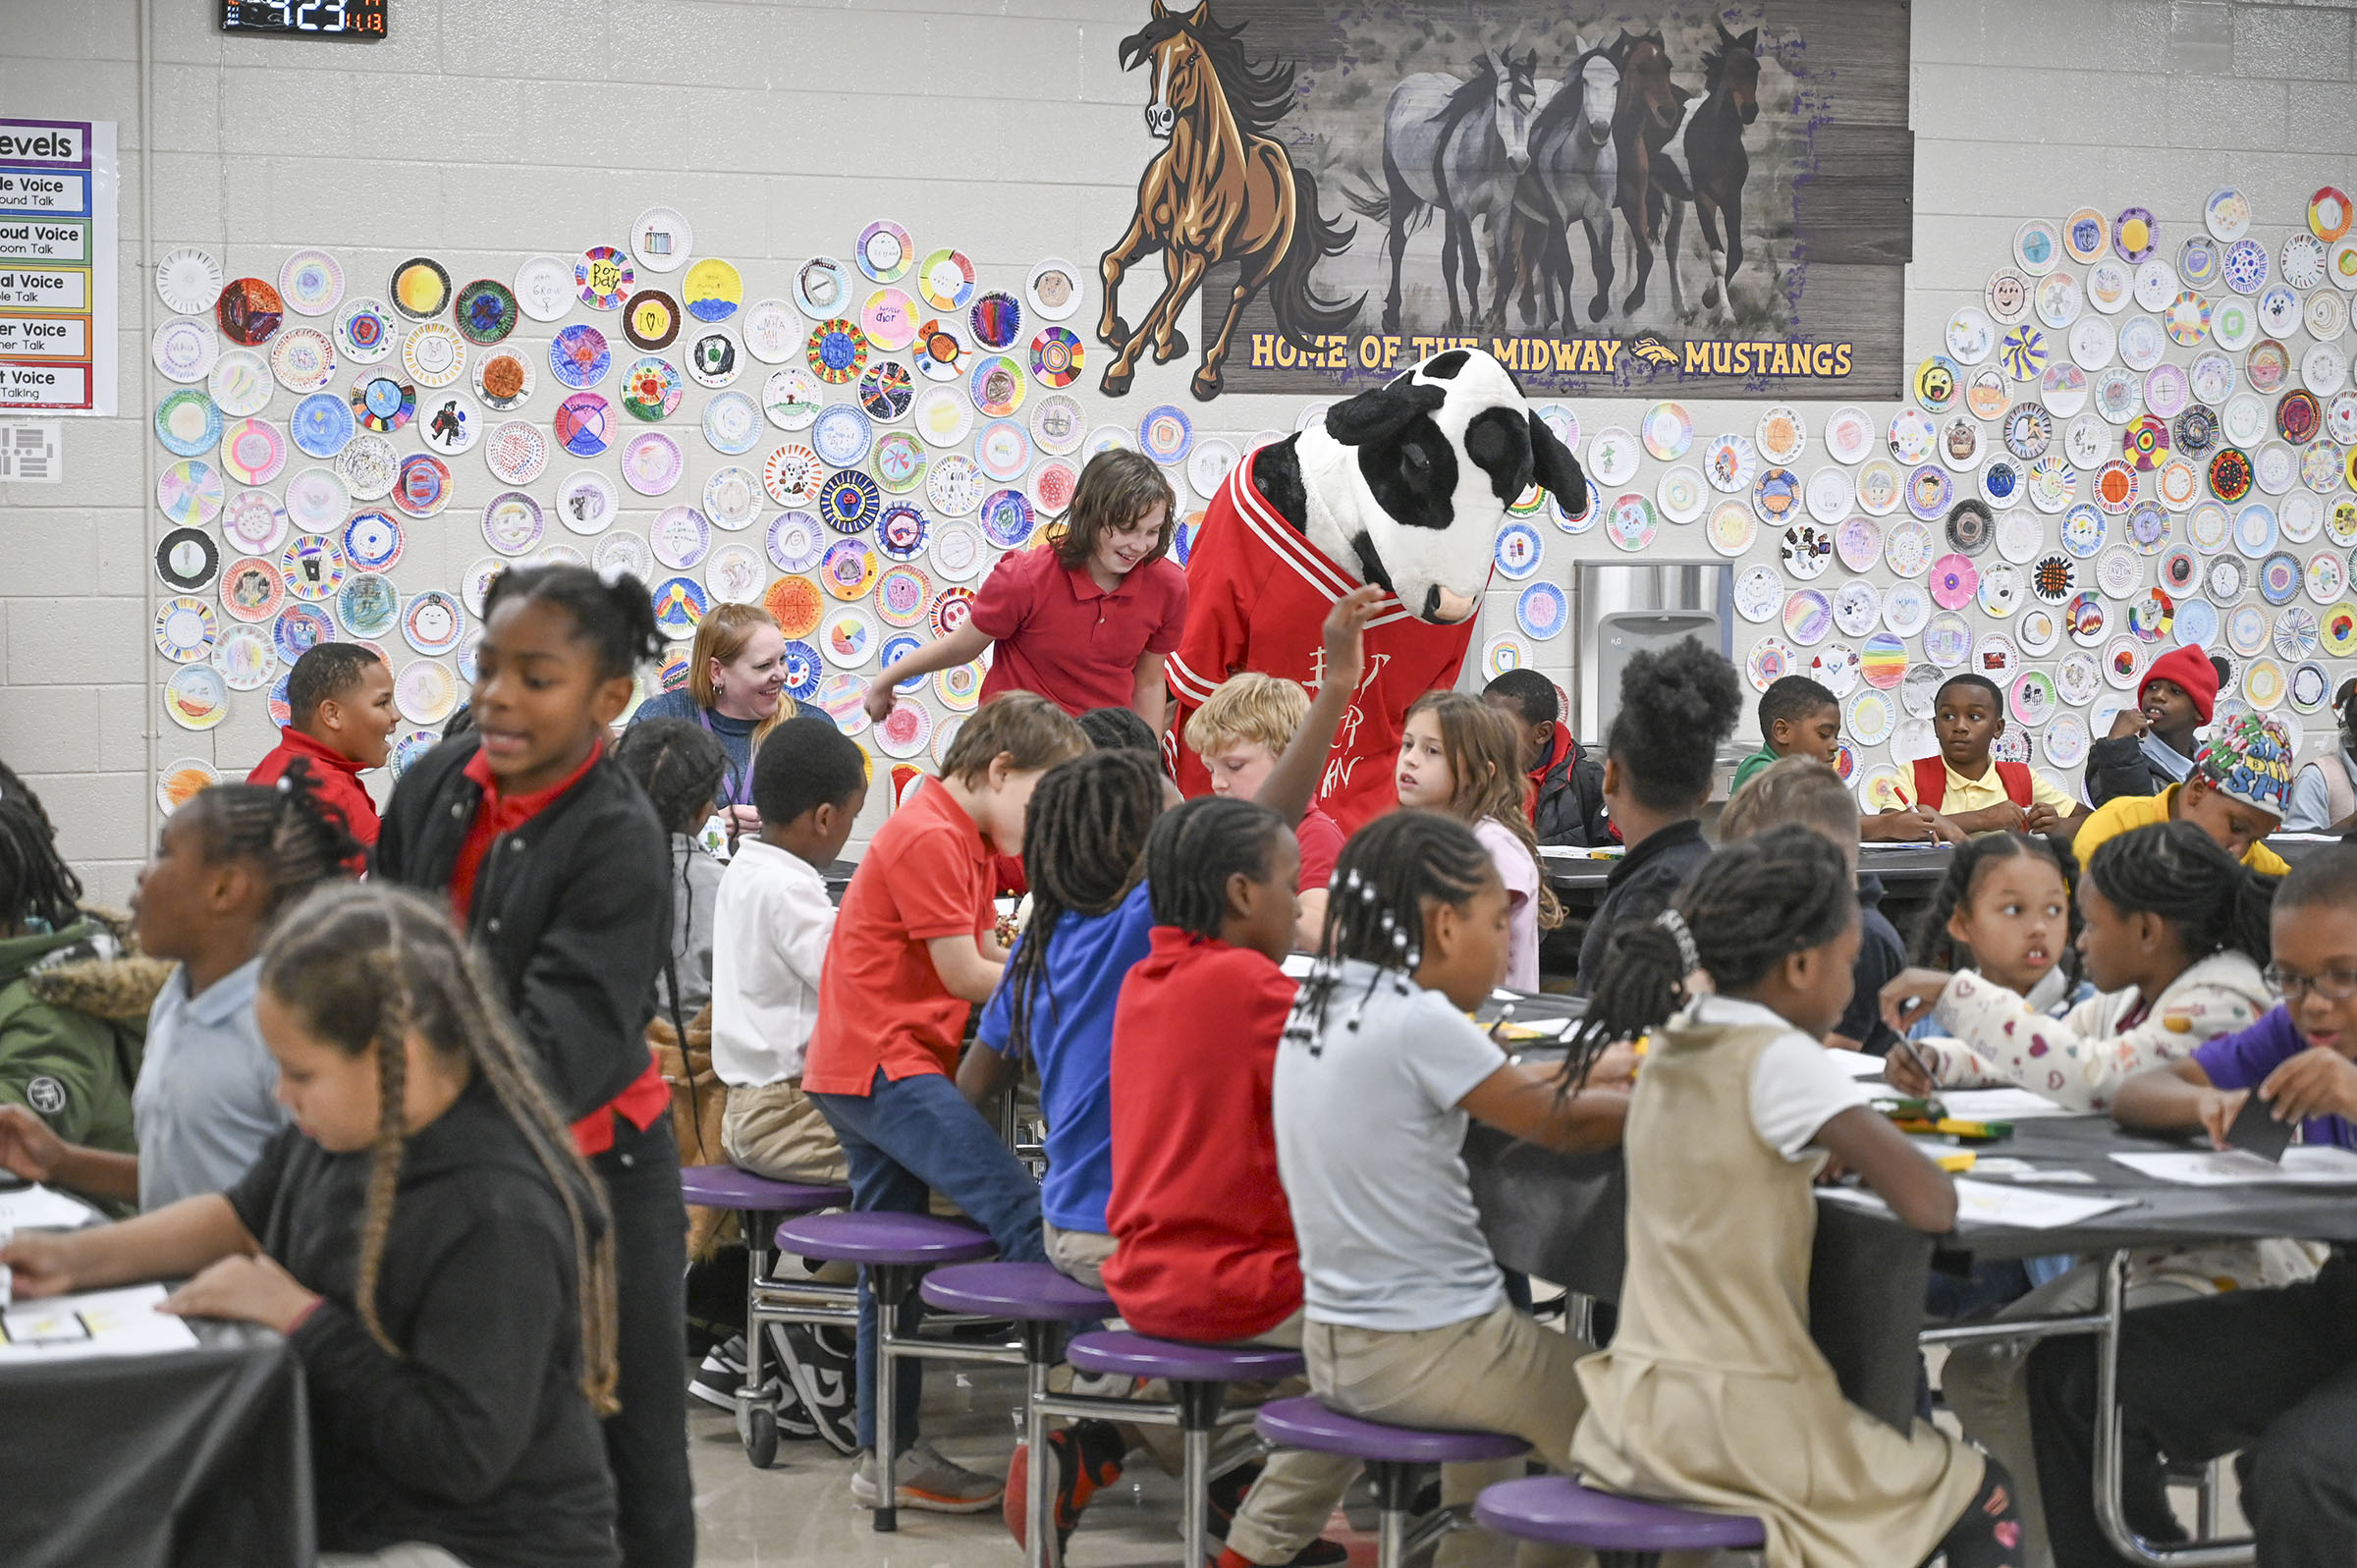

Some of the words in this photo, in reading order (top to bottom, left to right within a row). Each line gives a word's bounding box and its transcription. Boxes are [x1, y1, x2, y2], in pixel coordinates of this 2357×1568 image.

[0, 132, 72, 158] evels
[20, 178, 64, 193] Voice
[0, 195, 27, 205] ound
[31, 194, 55, 206] Talk
[0, 226, 29, 240] oud
[34, 226, 80, 242] Voice
[0, 244, 27, 253] oom
[30, 243, 54, 255] Talk
[0, 273, 15, 288] al
[20, 274, 64, 290] Voice
[0, 291, 12, 301] le
[16, 291, 38, 302] Talk
[0, 324, 17, 336] er
[23, 322, 67, 338] Voice
[22, 340, 45, 351] Talk
[1250, 332, 1349, 370] HOME
[1359, 334, 1402, 371] OF
[1492, 337, 1621, 373] MIDWAY
[1683, 340, 1854, 378] MUSTANGS
[12, 370, 55, 385] Voice
[1, 387, 40, 401] Talking
